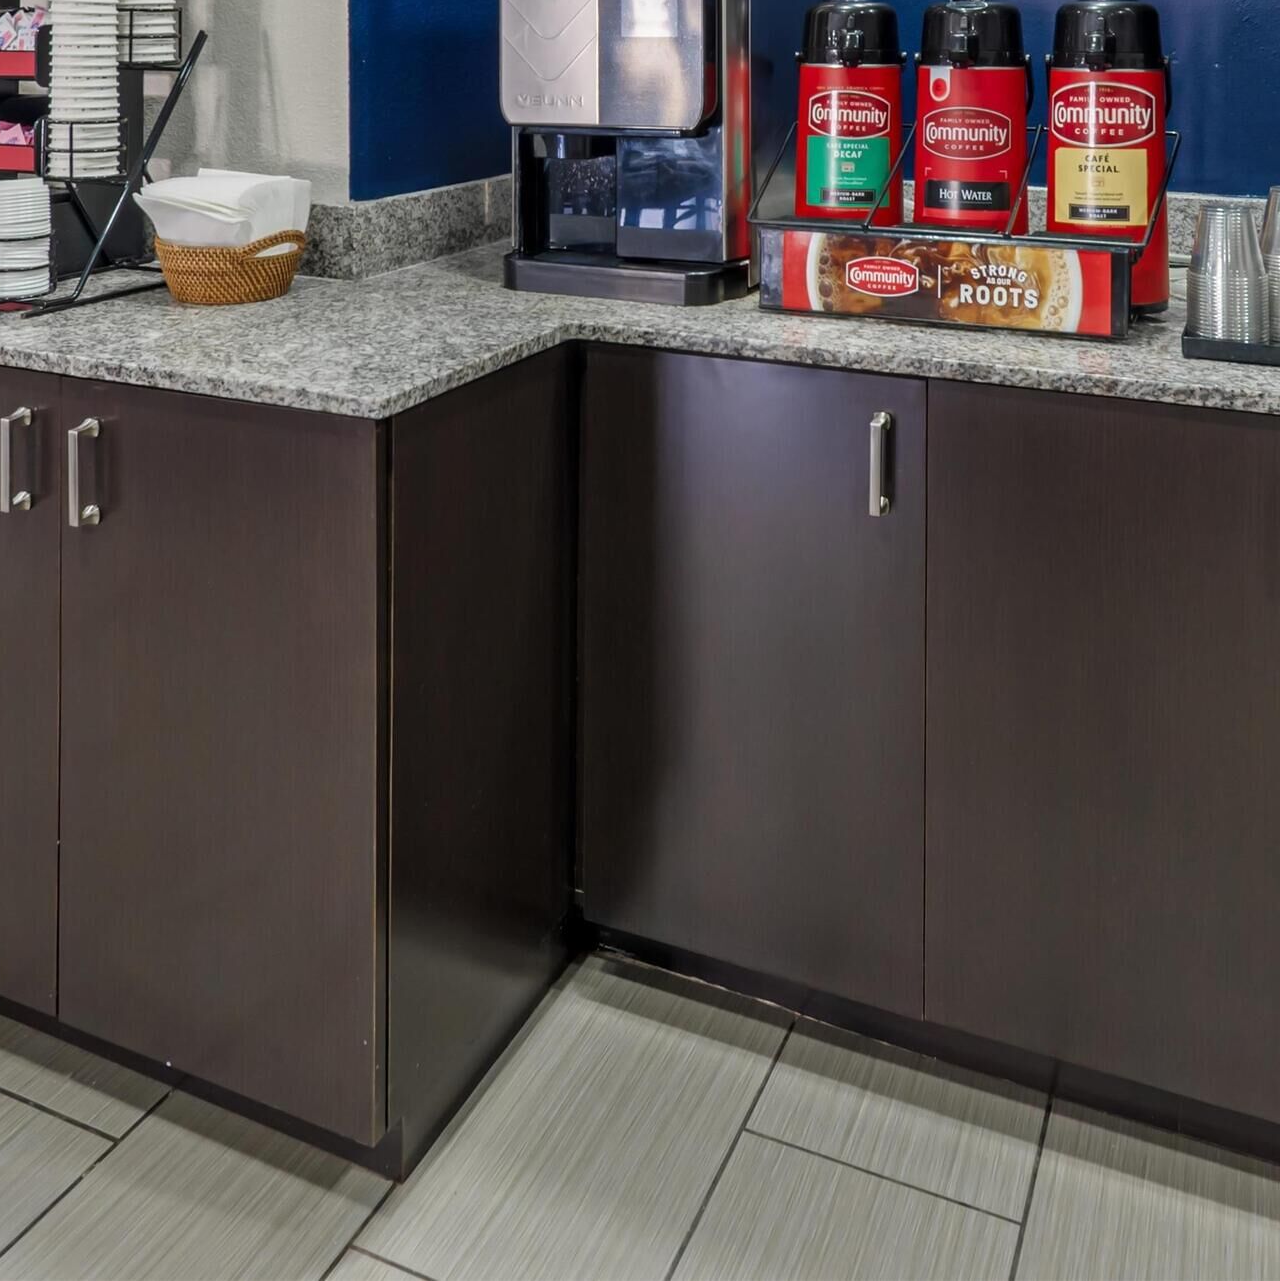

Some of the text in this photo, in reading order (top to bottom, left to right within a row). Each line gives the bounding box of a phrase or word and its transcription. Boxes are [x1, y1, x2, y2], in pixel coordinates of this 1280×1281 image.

[812, 103, 887, 127] Community
[1054, 101, 1151, 129] Community
[926, 122, 1007, 146] Community
[1074, 128, 1124, 136] COFEE
[833, 150, 863, 158] DECAF
[1085, 153, 1109, 163] CAFÉ
[1078, 165, 1119, 173] SPECIAL
[850, 266, 914, 287] Community
[971, 264, 1028, 282] STRONG
[997, 278, 1011, 286] OUR
[960, 284, 1038, 308] ROOTS
